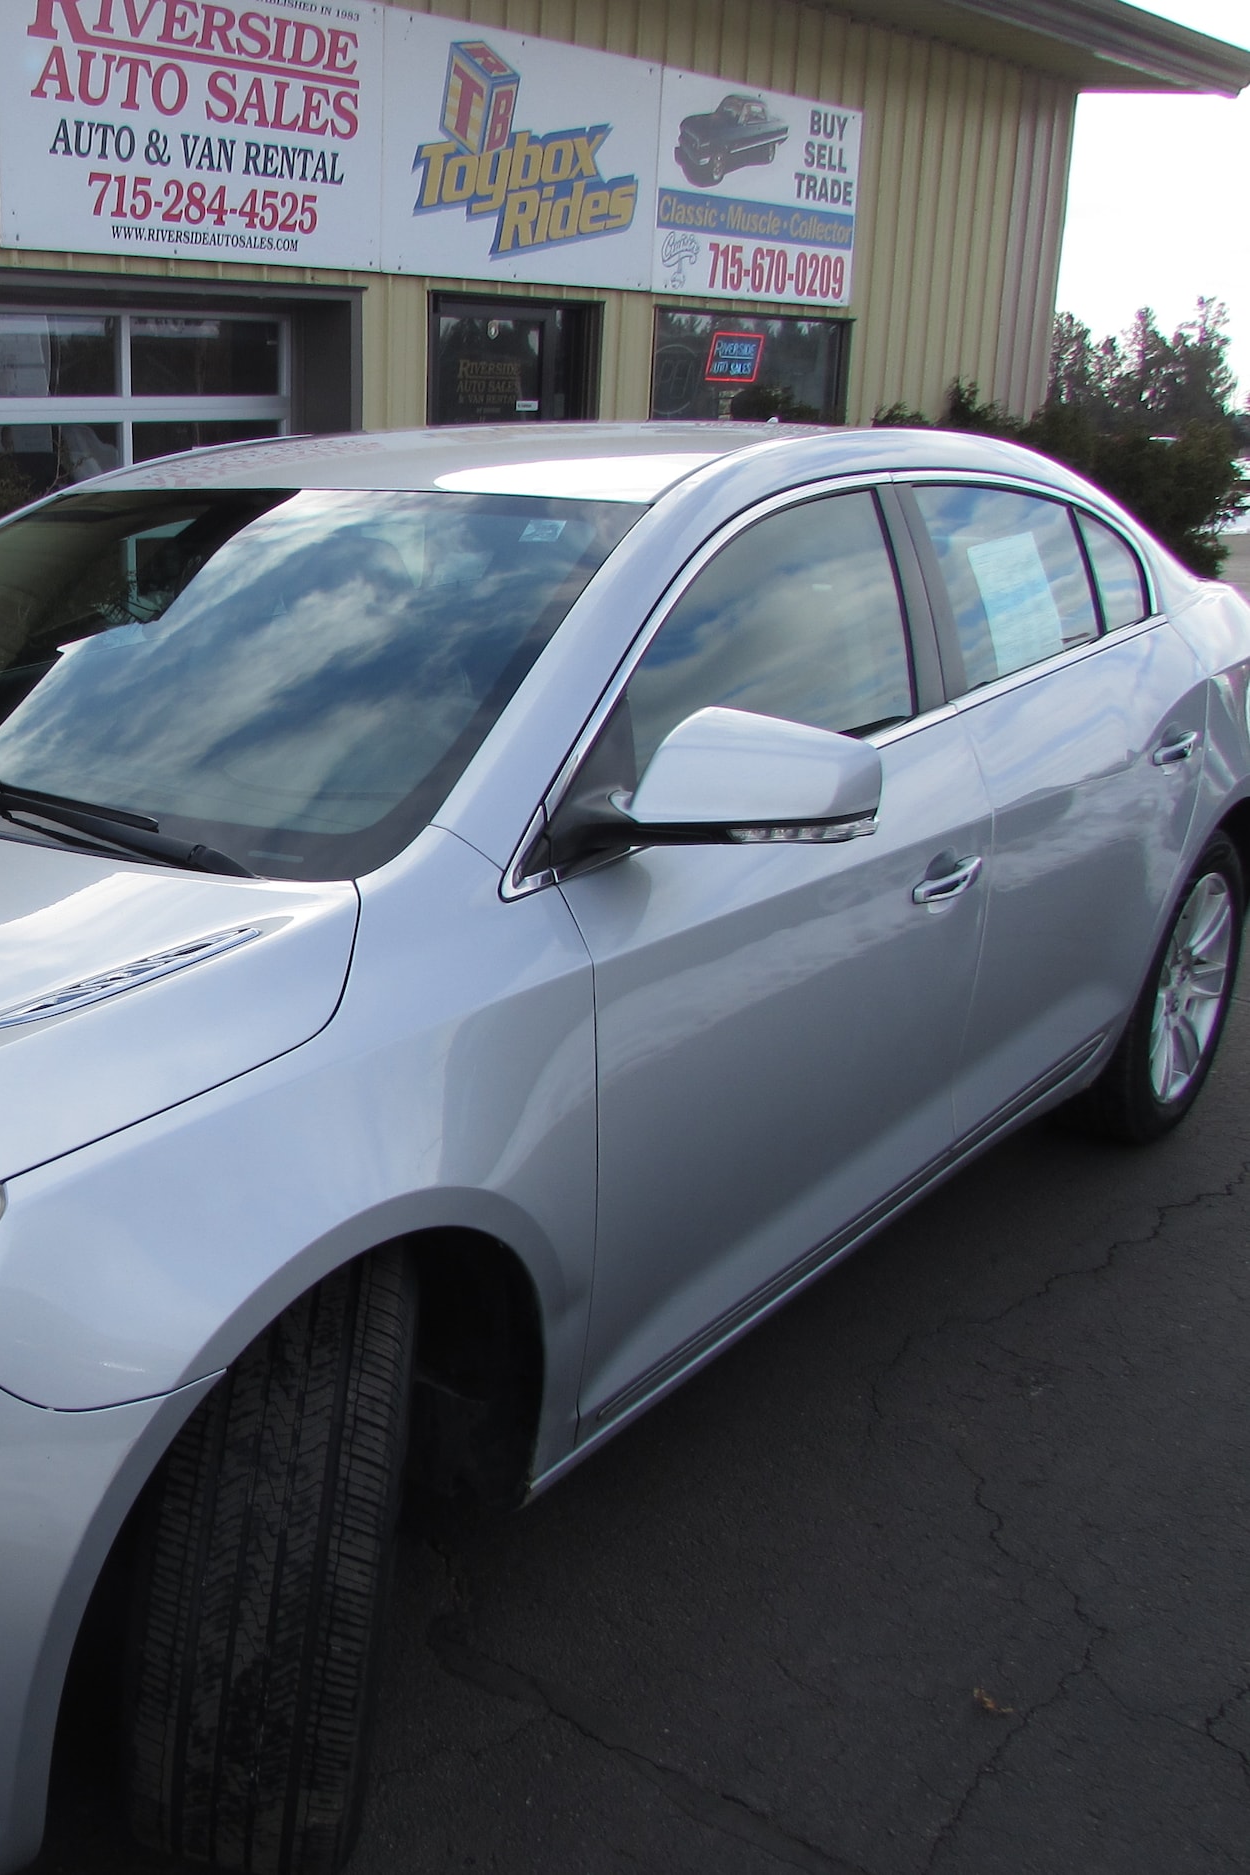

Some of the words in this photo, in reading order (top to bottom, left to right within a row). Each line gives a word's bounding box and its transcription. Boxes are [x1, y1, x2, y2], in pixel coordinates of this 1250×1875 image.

[320, 5, 332, 16] IN
[336, 9, 360, 22] 1983
[30, 46, 188, 117] AUTO
[204, 70, 359, 140] SALES
[810, 109, 848, 142] BUY
[50, 118, 136, 162] AUTO
[144, 129, 171, 167] &
[180, 133, 237, 174] VAN
[242, 142, 346, 186] RENTAL
[803, 140, 847, 174] SELL
[418, 129, 607, 215] Toybox
[87, 171, 318, 235] 715-284-4525
[794, 172, 853, 207] TRADE
[496, 178, 638, 253] Rides
[659, 195, 717, 228] Classic
[726, 204, 781, 236] Muscle
[789, 212, 853, 244] Collector
[111, 225, 299, 252] WWW.RIVERSIDEAUTOSALES.COM
[708, 242, 845, 299] 715-670-0209
[714, 340, 757, 357] RIVERSIDE
[458, 359, 521, 378] RIVERSIDE
[729, 362, 752, 376] SALES
[457, 379, 485, 393] AUTO
[488, 380, 521, 393] SALES
